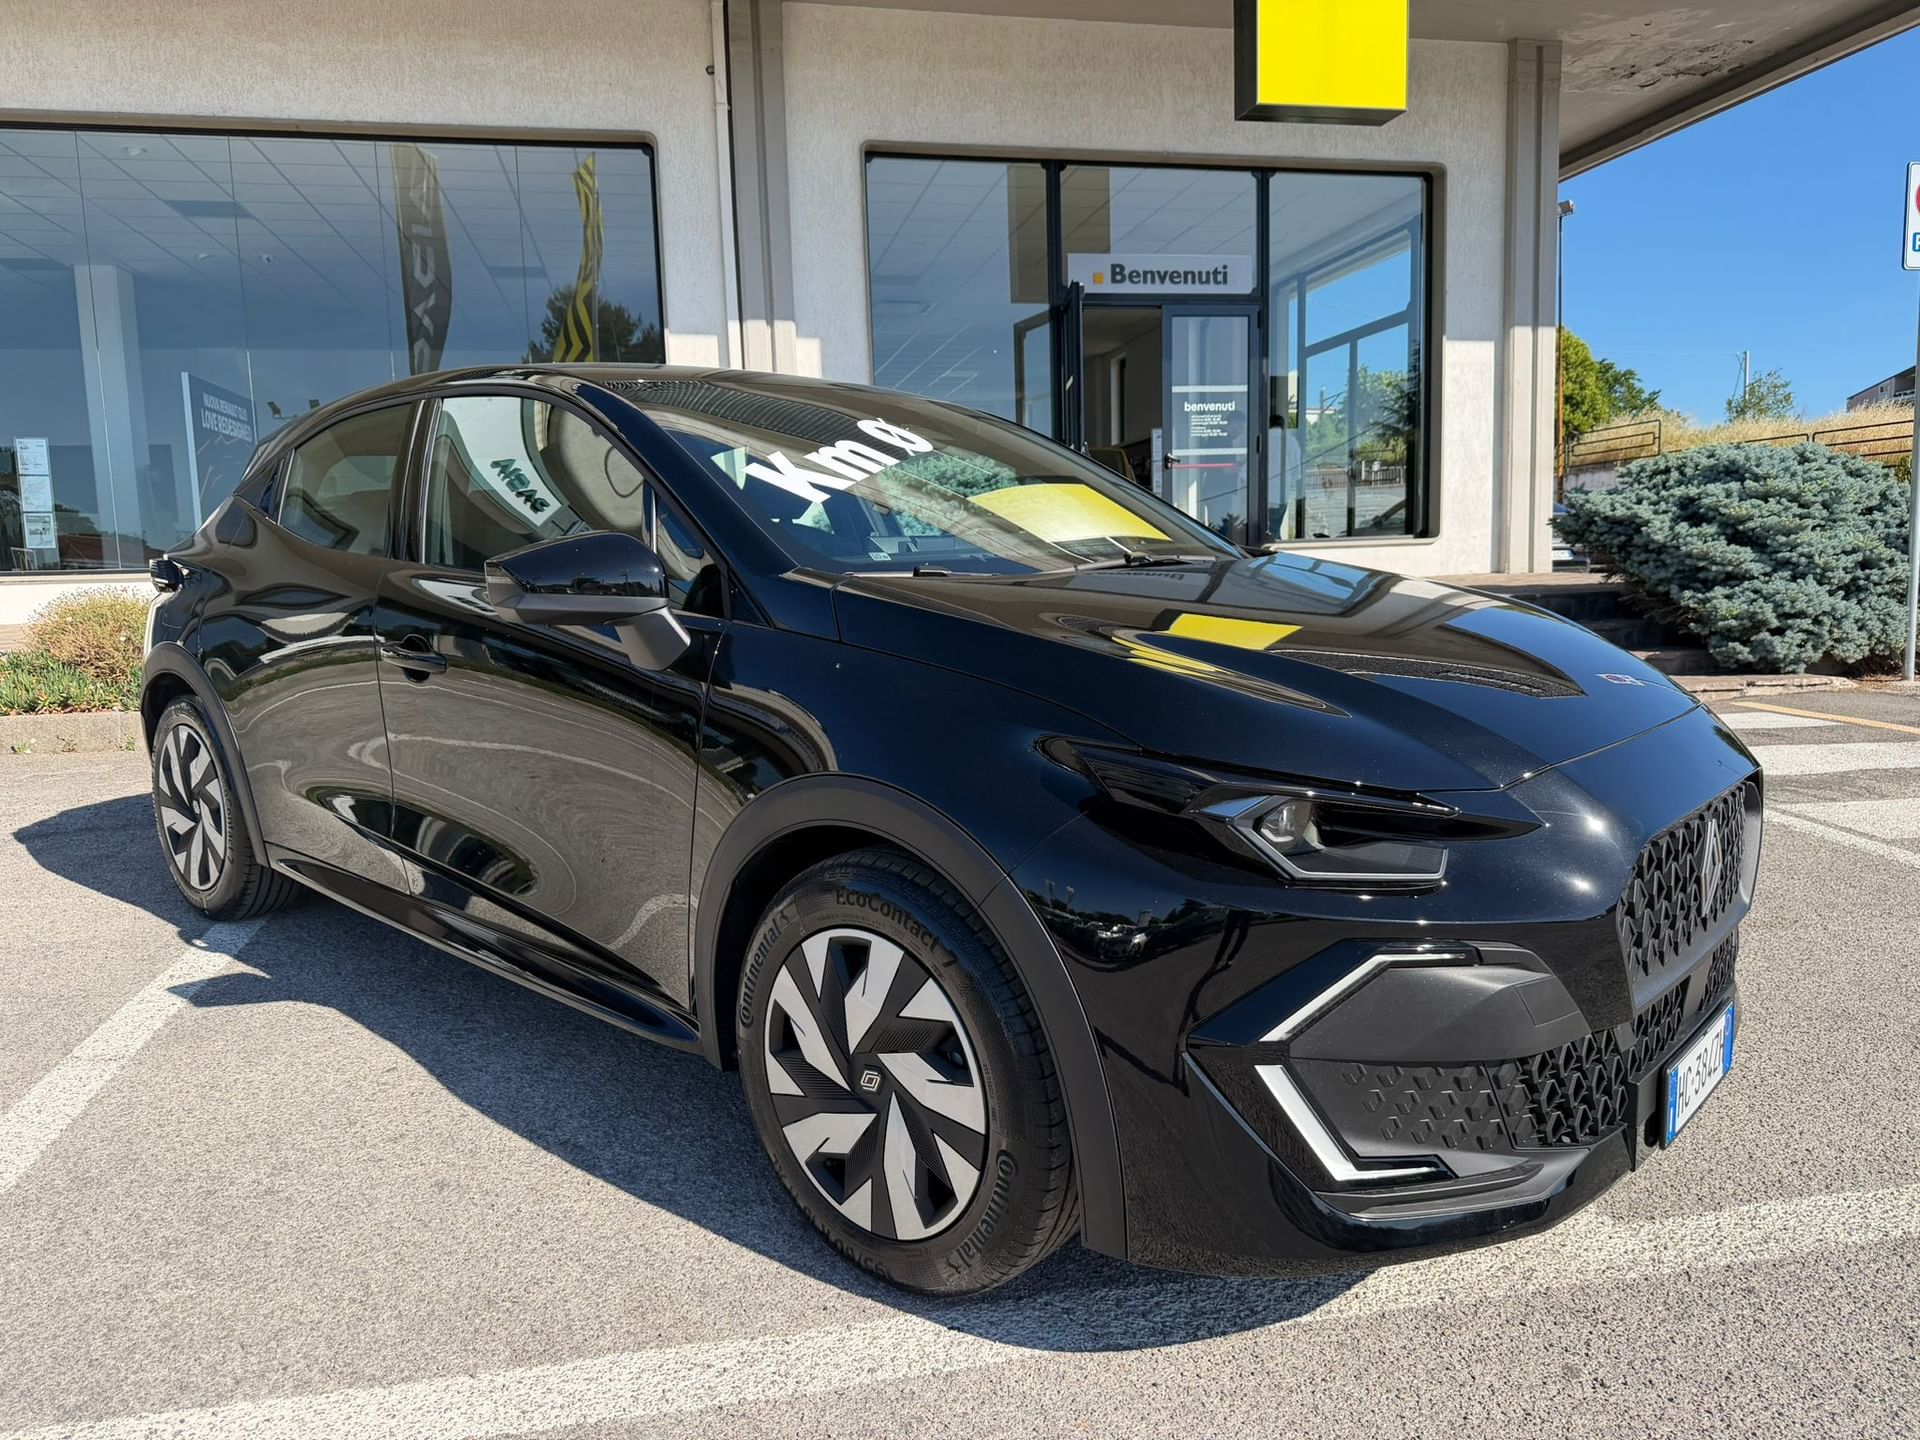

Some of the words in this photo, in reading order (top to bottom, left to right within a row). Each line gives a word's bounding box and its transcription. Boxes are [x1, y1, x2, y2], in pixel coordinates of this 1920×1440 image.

[1110, 263, 1229, 286] Benvenuti
[1184, 401, 1236, 412] benvenuti
[836, 888, 944, 950] EcoContact
[740, 918, 783, 1029] Continental
[957, 1149, 1018, 1269] Continental
